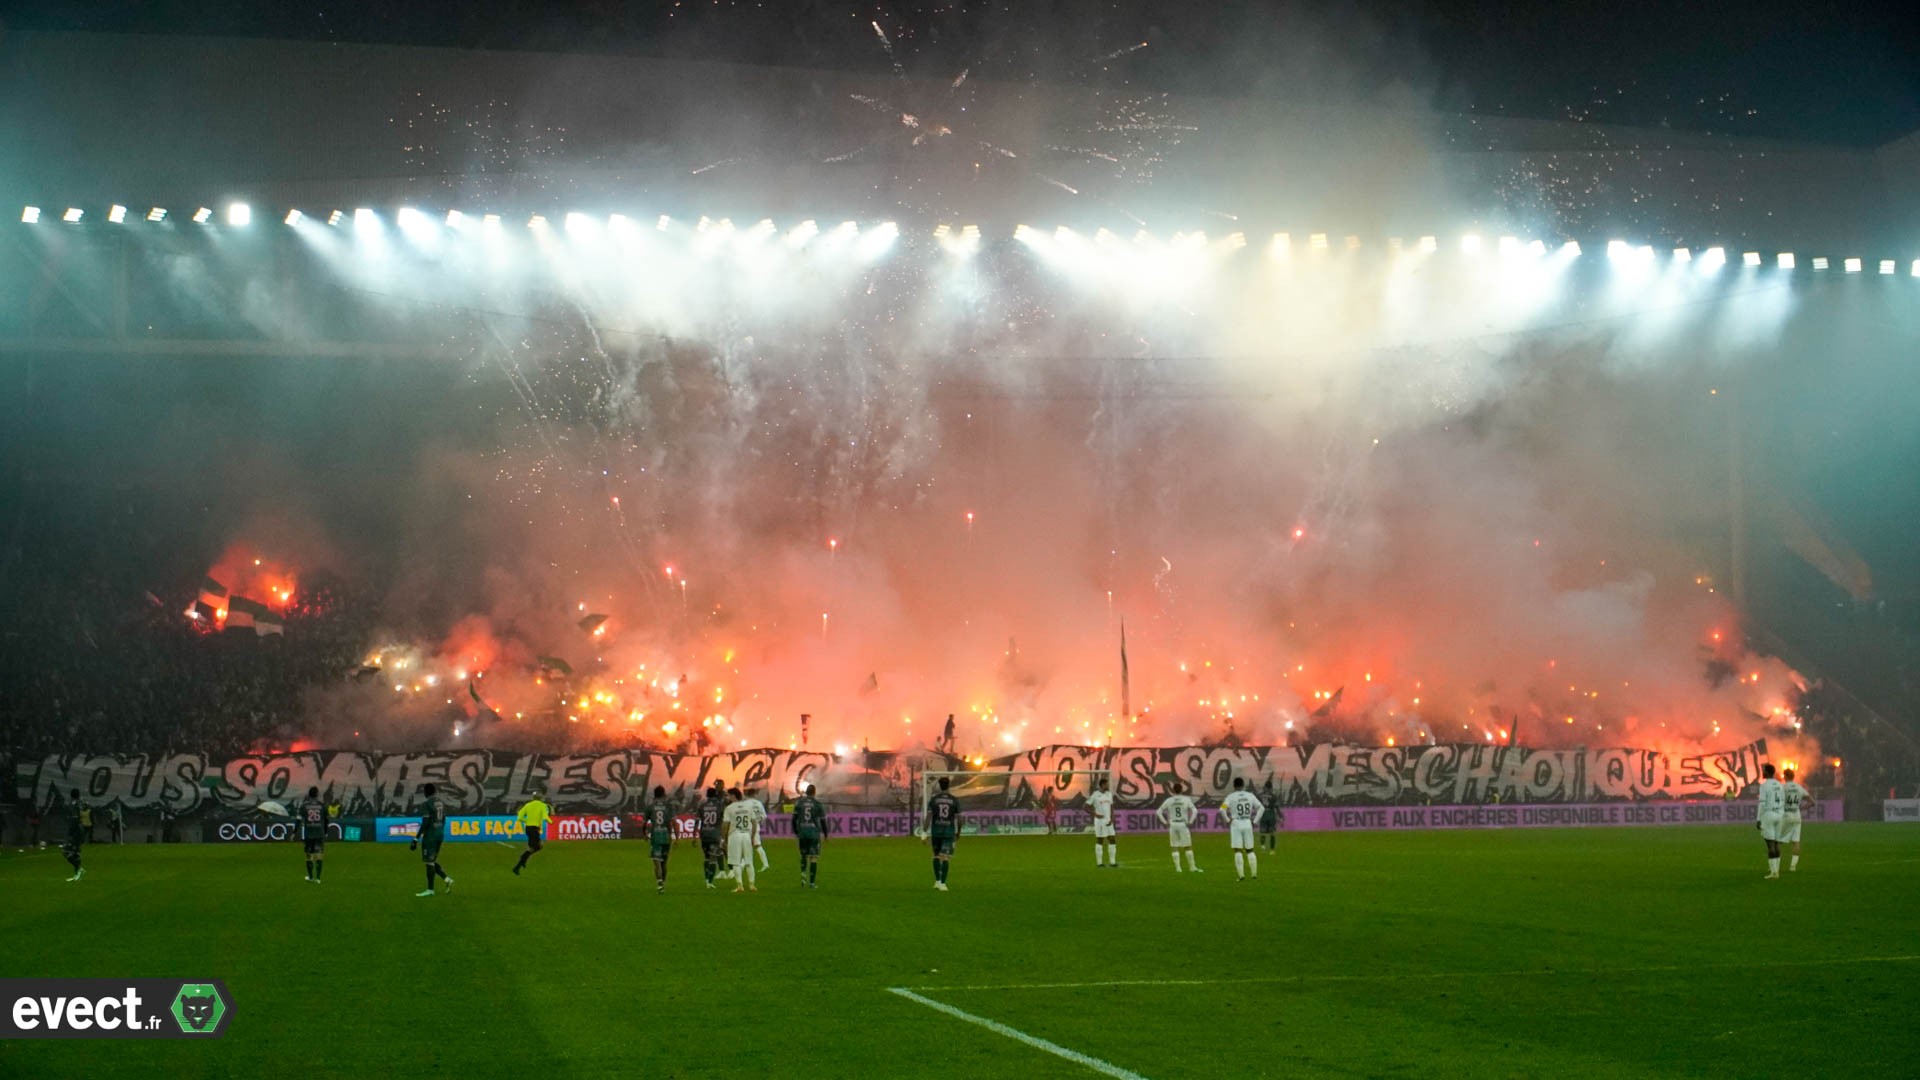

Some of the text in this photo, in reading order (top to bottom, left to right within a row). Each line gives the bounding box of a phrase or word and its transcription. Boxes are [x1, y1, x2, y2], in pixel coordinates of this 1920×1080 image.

[36, 752, 208, 814] NOUS
[211, 751, 493, 814] SOMMES
[508, 751, 634, 812] LES
[1006, 745, 1159, 808] NOUS
[1168, 744, 1409, 806] SOMMES
[307, 809, 320, 821] 26
[804, 807, 811, 820] 5
[939, 804, 950, 818] 13
[1175, 807, 1182, 818] 8
[1237, 803, 1250, 816] 98
[1332, 810, 1386, 827] VENTE
[1392, 809, 1426, 827] AUX
[1431, 806, 1517, 826] ENCHÈRES
[1523, 806, 1618, 825] DISPONIBLE
[1660, 806, 1681, 823] CE
[1684, 805, 1722, 821] SOIR
[656, 811, 664, 824] 8
[704, 812, 717, 824] 20
[736, 815, 749, 829] 26
[451, 820, 480, 837] BAS
